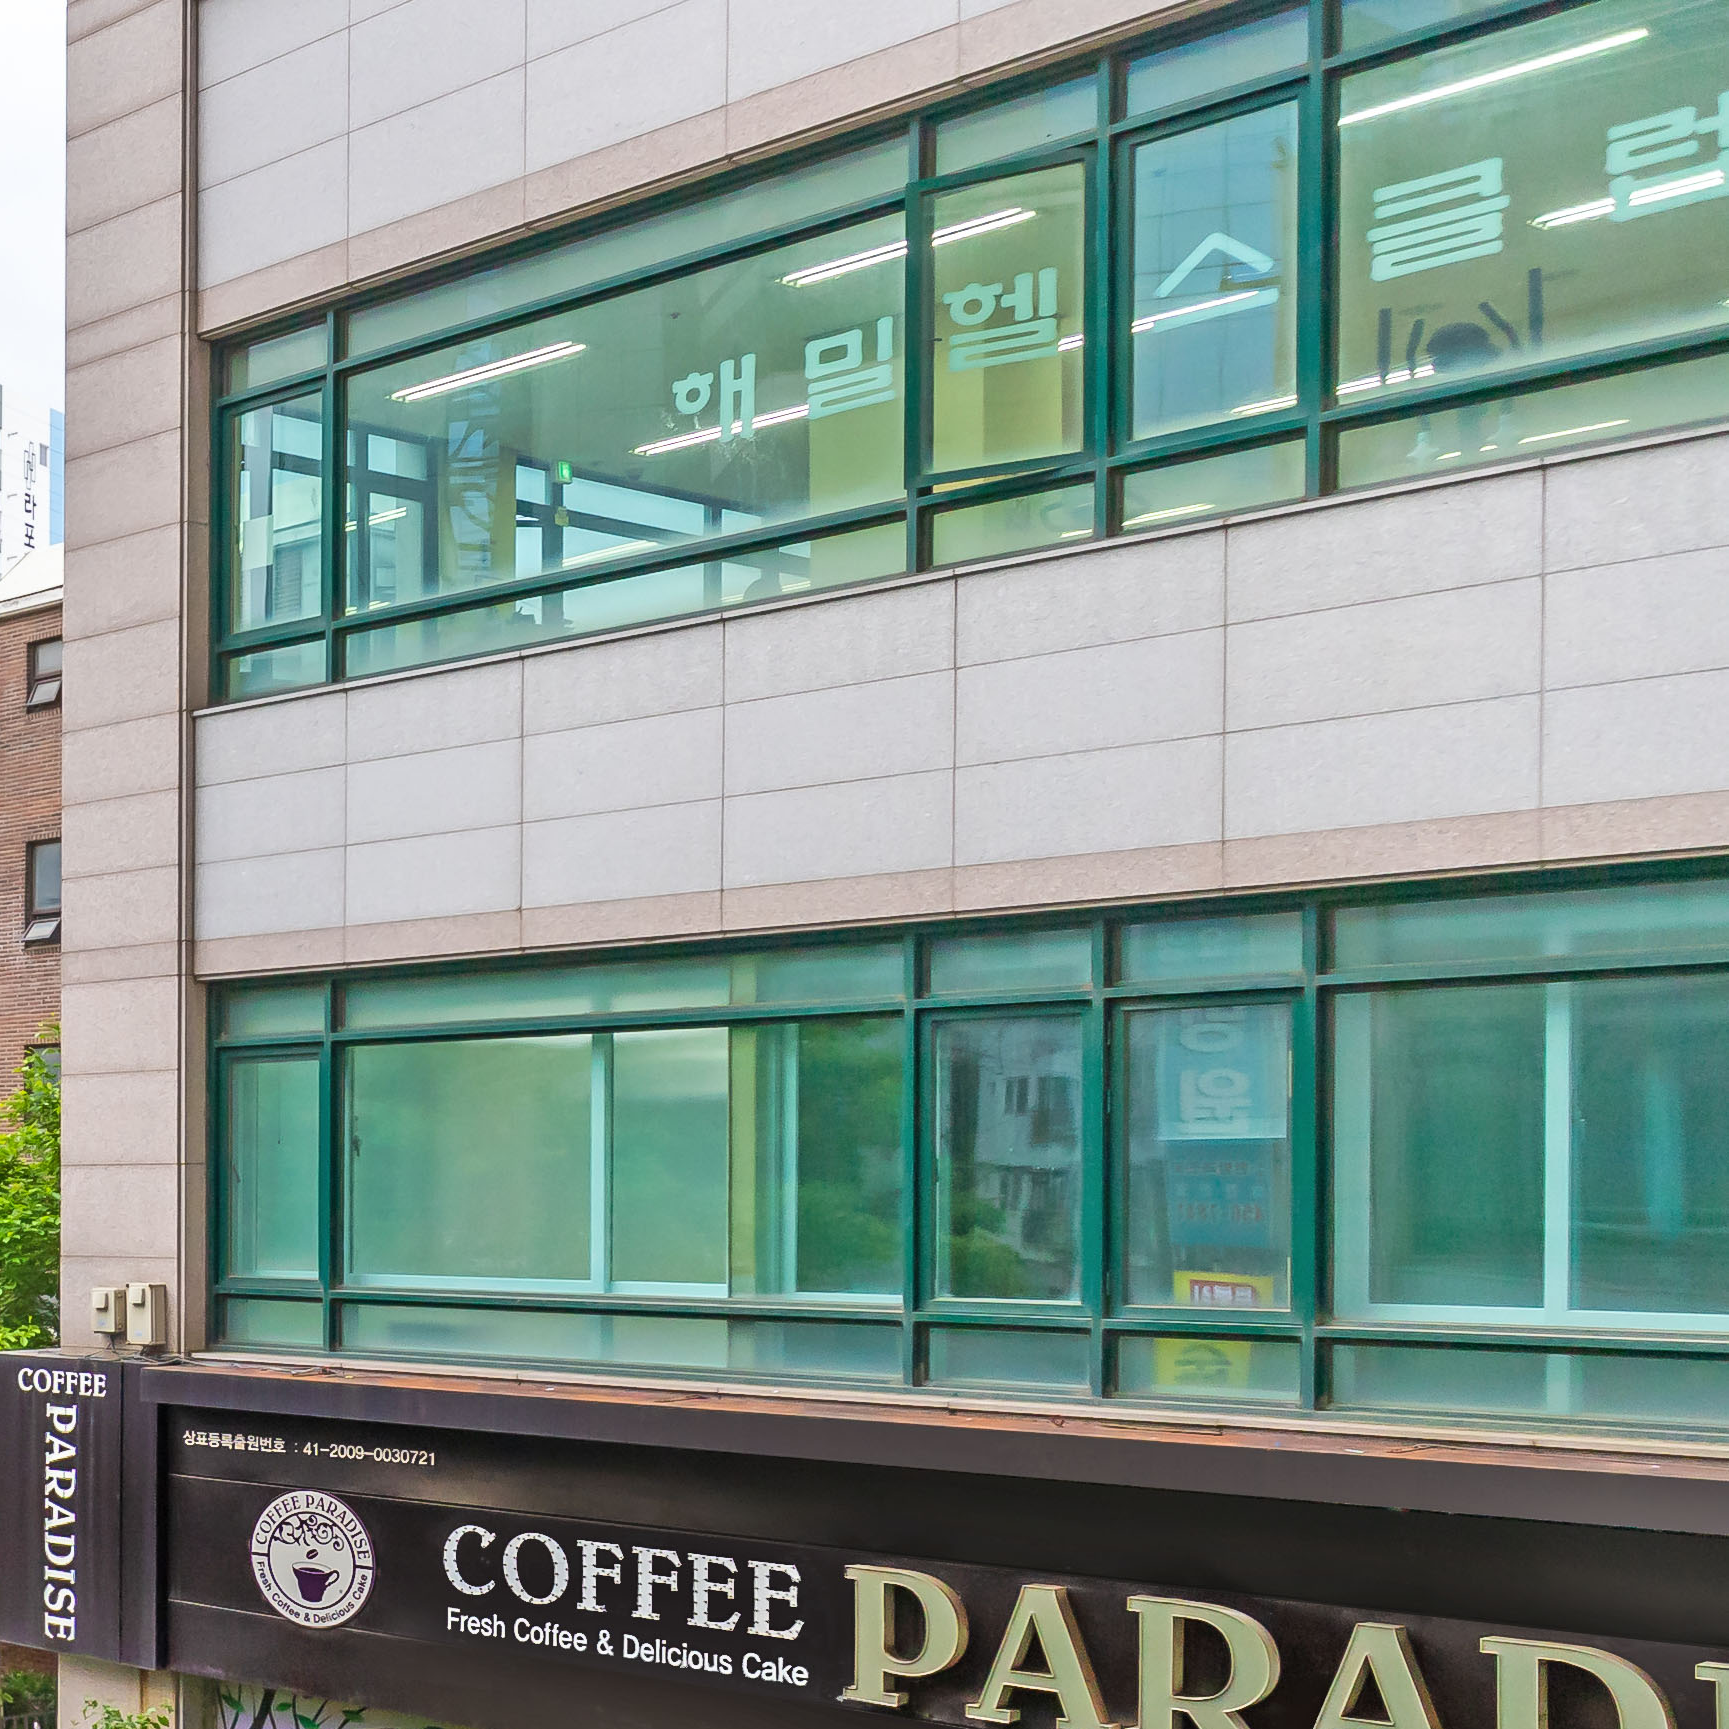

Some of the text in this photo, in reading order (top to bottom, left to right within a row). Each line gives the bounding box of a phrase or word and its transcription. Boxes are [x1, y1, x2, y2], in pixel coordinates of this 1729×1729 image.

[18, 1367, 107, 1398] COFFEE
[182, 1428, 287, 1456] 상표등록출원번호
[302, 1441, 437, 1467] 41-2009-0030721
[44, 1402, 79, 1643] PARADISE
[255, 1494, 371, 1560] COFFEE PARADISE
[256, 1561, 272, 1592] Fresh
[271, 1592, 301, 1619] Coffee
[313, 1601, 355, 1624] Delicious
[352, 1573, 368, 1600] Cake
[442, 1523, 806, 1641] COFFEE
[446, 1606, 809, 1689] Fresh Coffee & Delicious Cake
